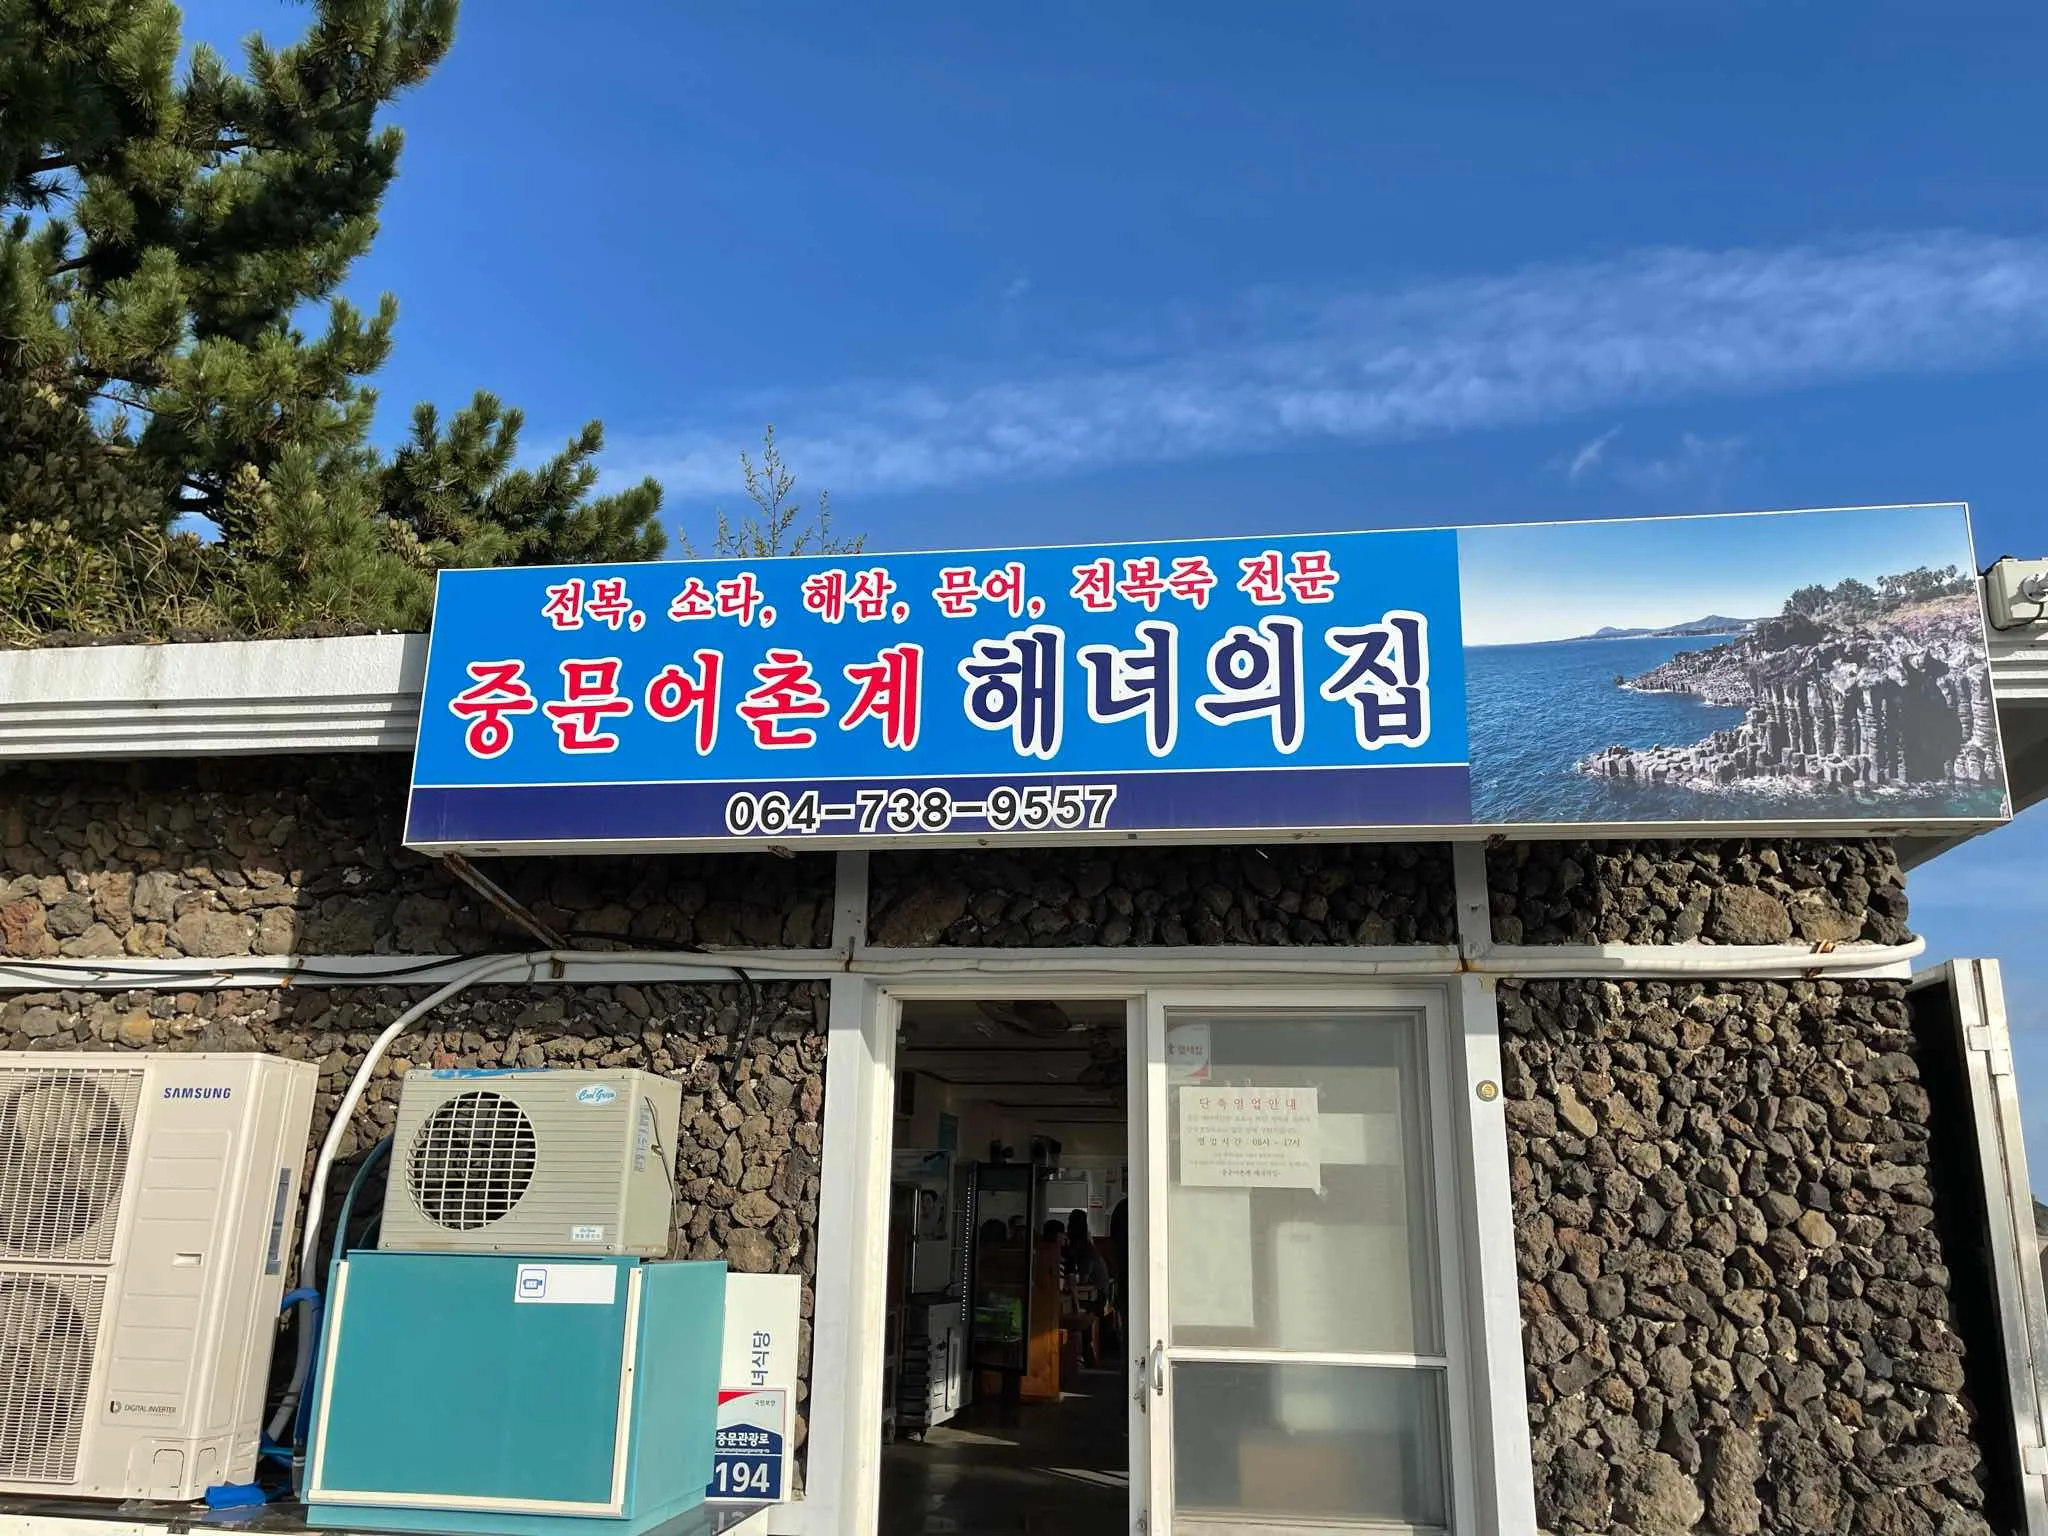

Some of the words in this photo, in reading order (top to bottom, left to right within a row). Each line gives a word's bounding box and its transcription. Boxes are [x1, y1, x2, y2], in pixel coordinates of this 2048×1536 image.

[542, 577, 645, 631] 전복,
[668, 572, 776, 628] 소라,
[802, 567, 910, 624] 해삼,
[933, 562, 1044, 619] 문어,
[1071, 554, 1217, 613] 전복죽
[1238, 549, 1340, 604] 전문
[449, 642, 923, 757] 중문어촌계
[958, 610, 1431, 760] 해녀의집
[725, 784, 1118, 834] 064-738-9557
[163, 1087, 231, 1099] SAMSUNG
[715, 1431, 770, 1446] 중문관광로
[715, 1461, 770, 1493] 194
